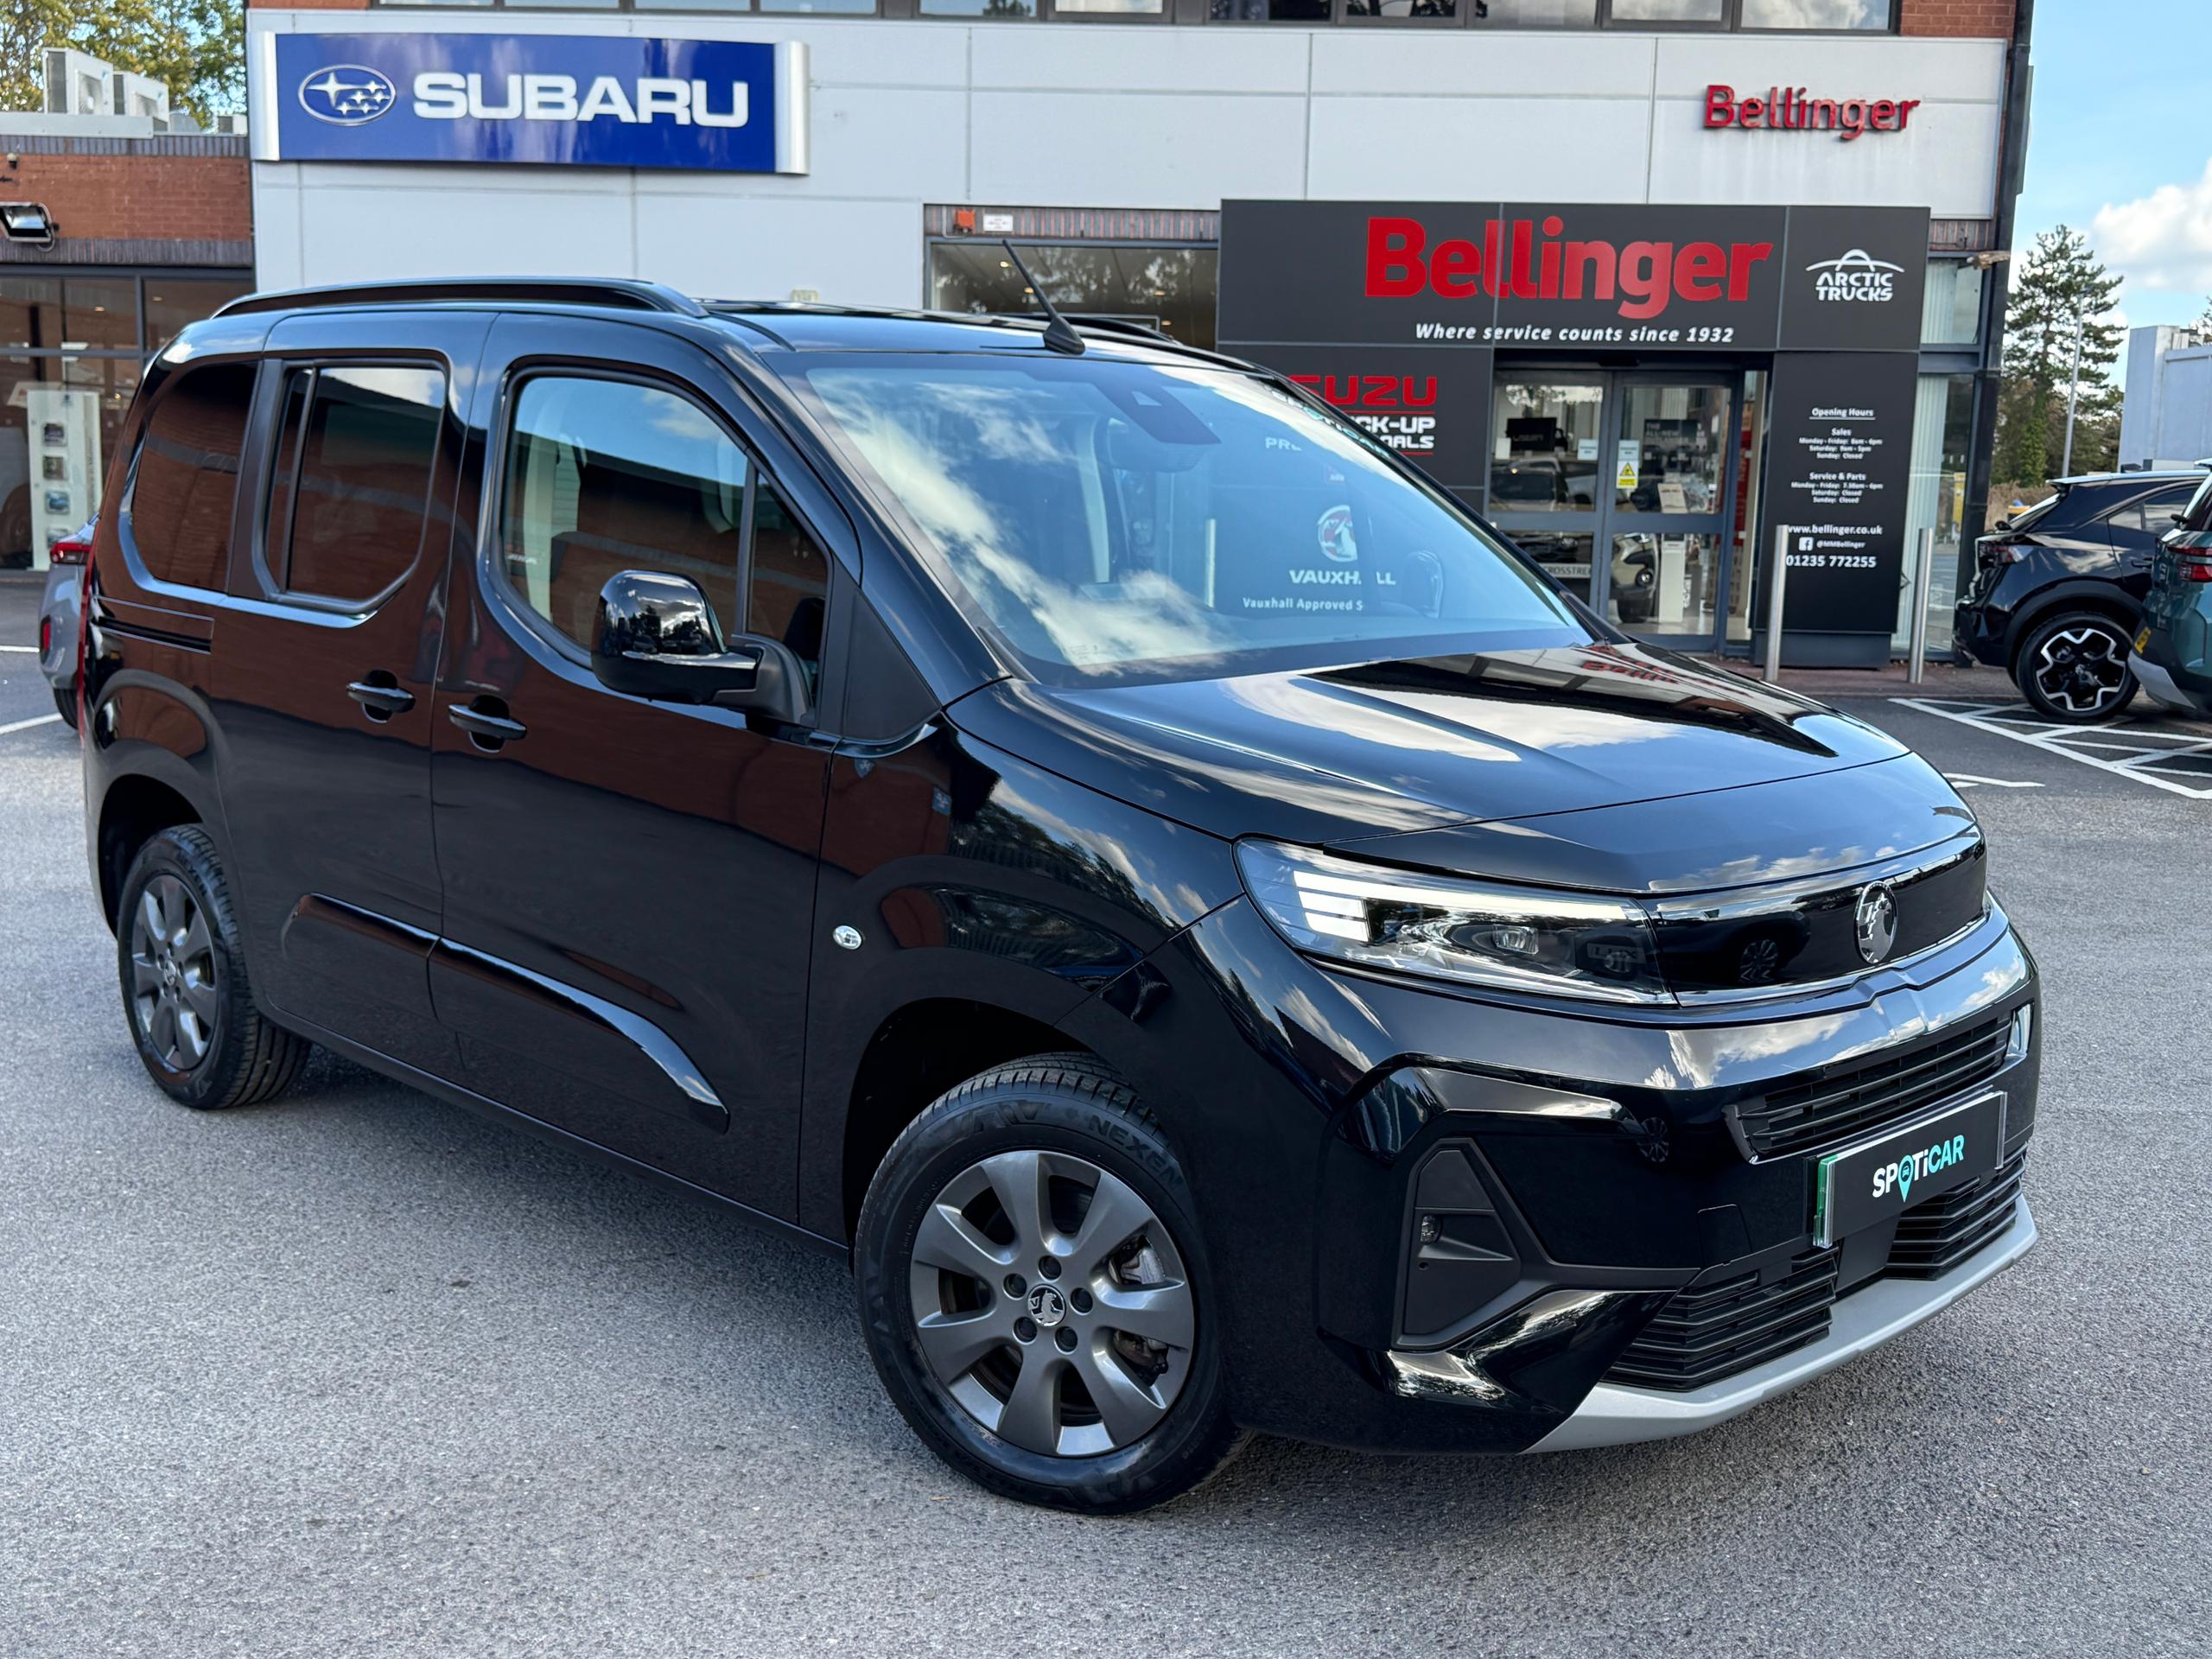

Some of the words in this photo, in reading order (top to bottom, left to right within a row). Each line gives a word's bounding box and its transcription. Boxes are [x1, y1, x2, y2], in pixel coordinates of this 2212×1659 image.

[413, 73, 749, 128] SUBARU
[1704, 85, 1921, 140] Bellinger
[1364, 215, 1774, 319] Bellinger
[1815, 271, 1894, 287] ARCTIC
[1815, 286, 1894, 302] TRUCKS
[1415, 322, 1476, 340] Where
[1483, 324, 1552, 341] service
[1559, 325, 1623, 342] counts
[1629, 326, 1680, 343] since
[1686, 327, 1735, 343] 1932
[1288, 374, 1438, 406] UZU
[1812, 408, 1847, 418] Opening
[1848, 408, 1874, 416] Hours
[1831, 428, 1852, 436] Sales
[1809, 472, 1838, 480] Service
[1847, 473, 1866, 481] Parts
[1788, 524, 1883, 536] www.bellinger.co.uk
[1785, 555, 1826, 567] 01235
[1829, 555, 1877, 569] 772255
[1288, 569, 1396, 585] VAUXHLL
[1243, 597, 1294, 608] Vauxhall
[1296, 599, 1353, 611] Approved
[1089, 1115, 1183, 1186] NEXEN
